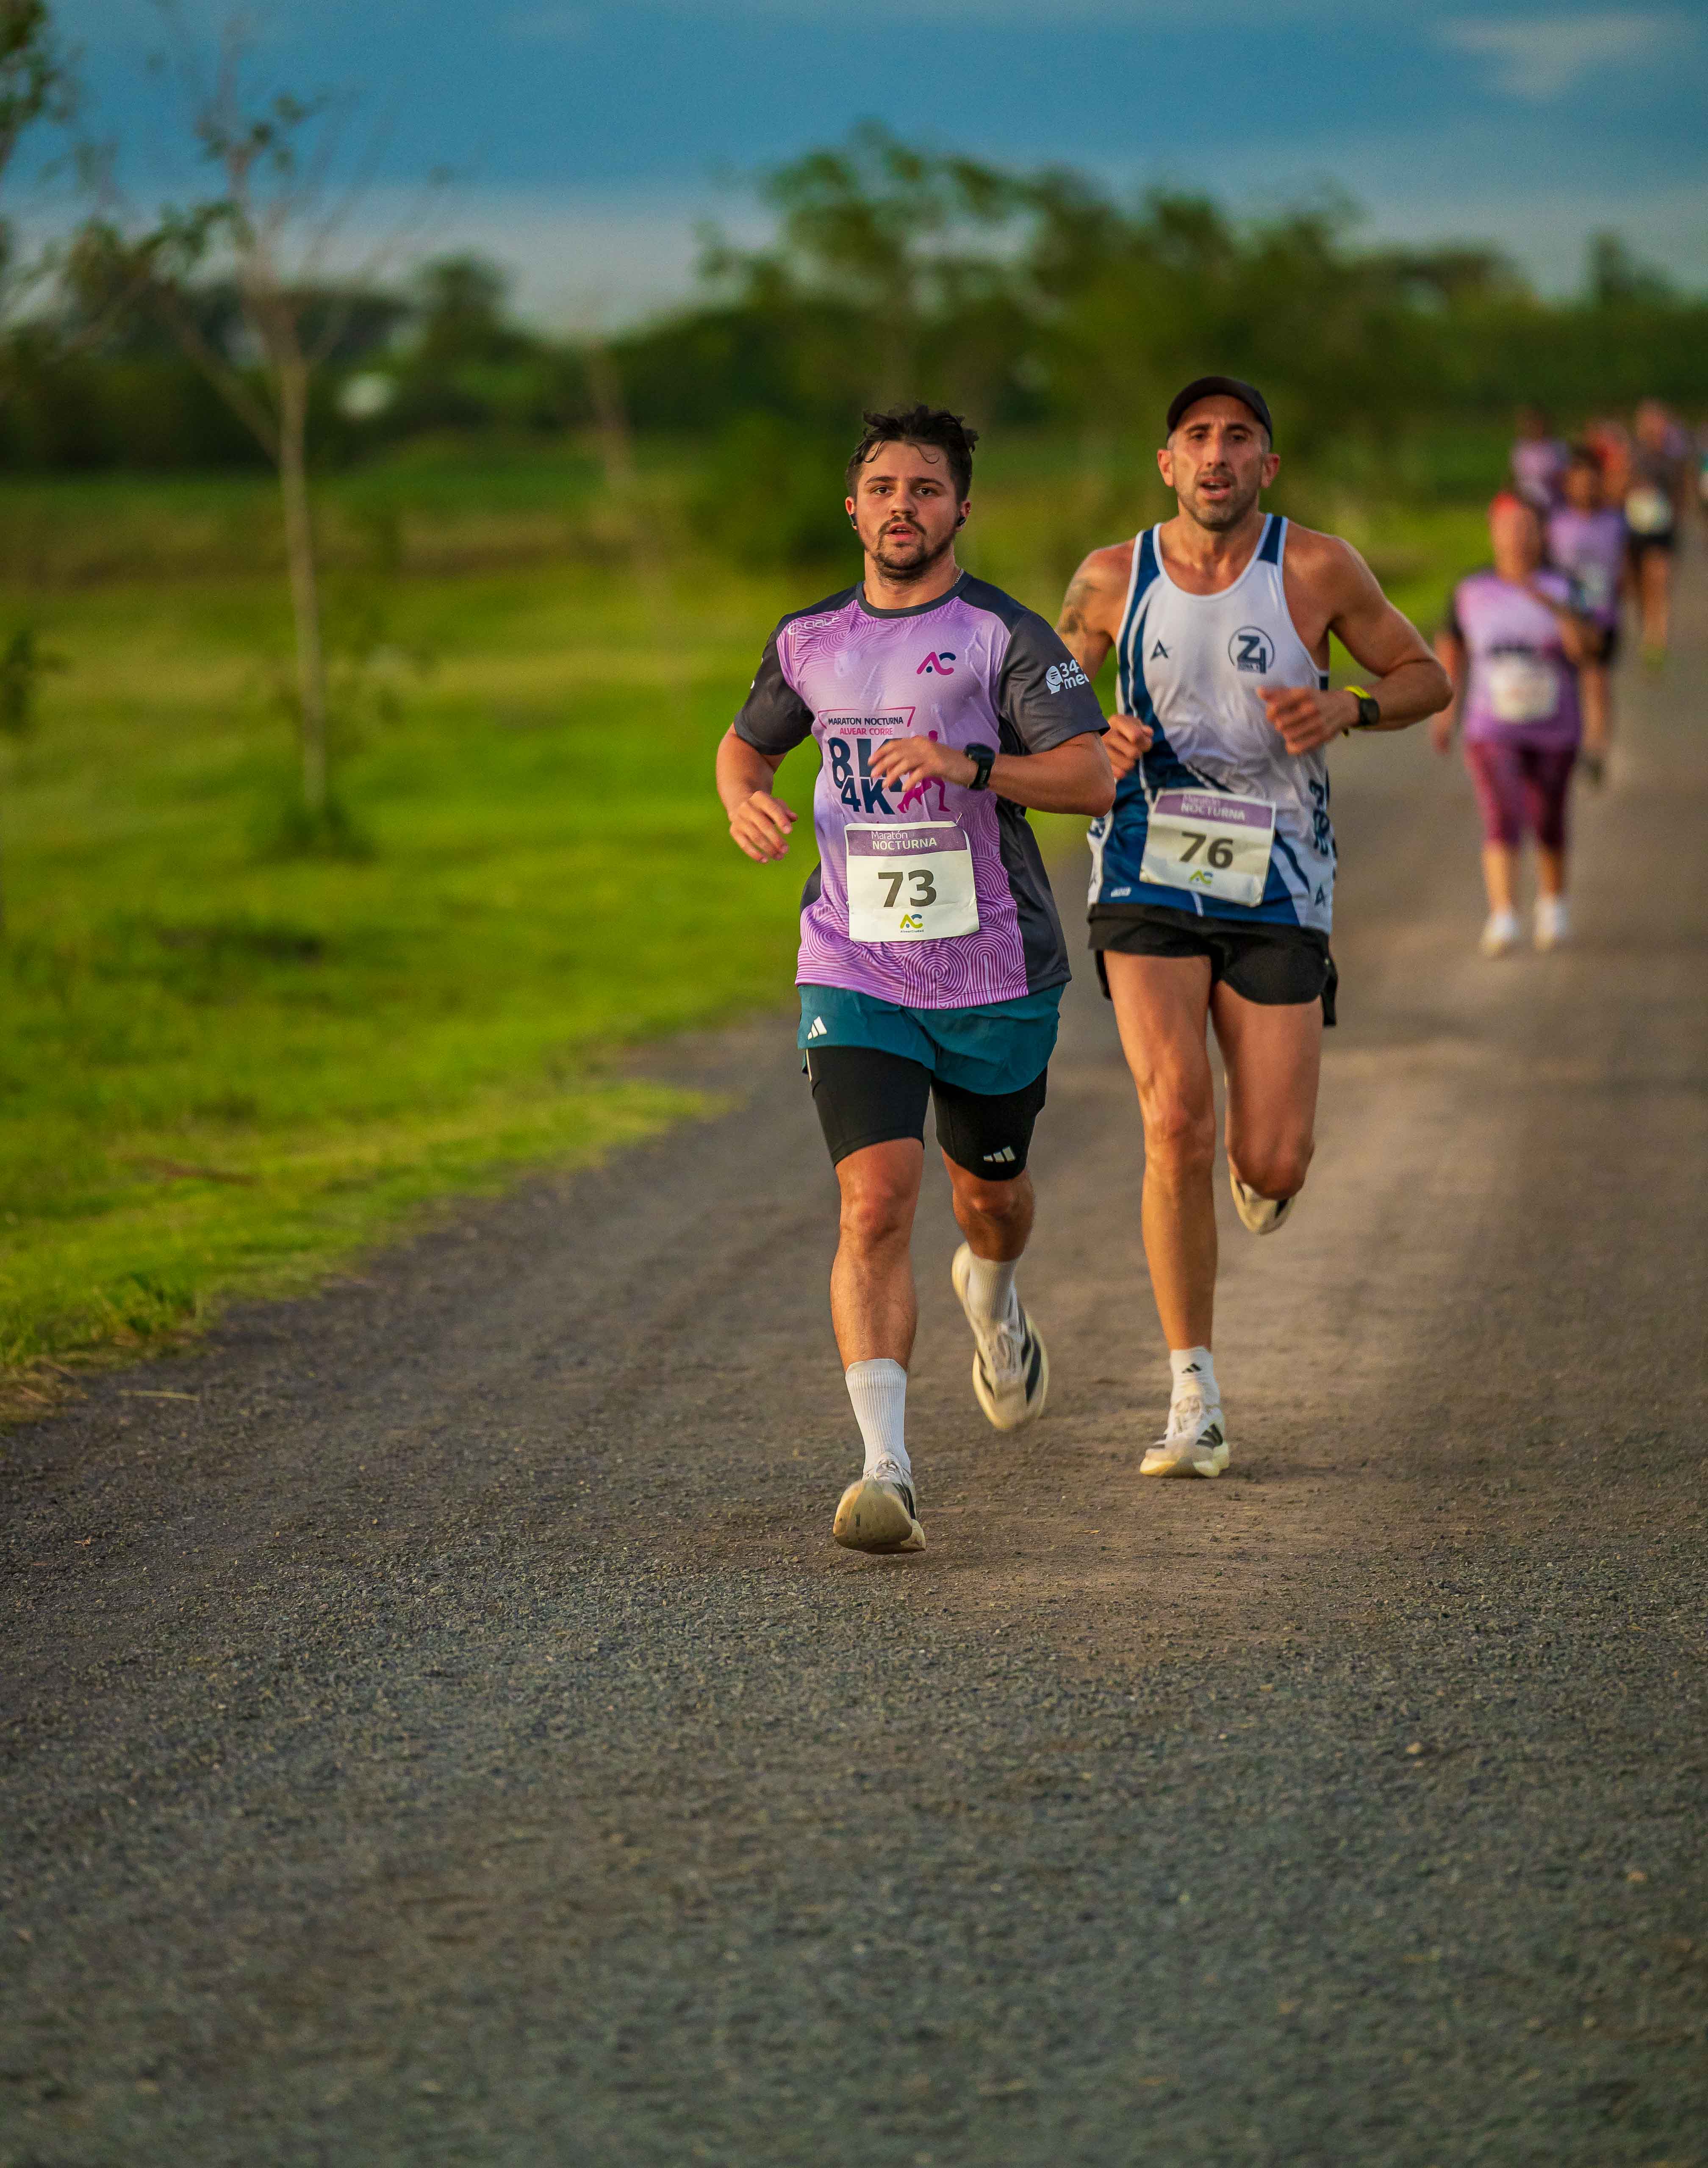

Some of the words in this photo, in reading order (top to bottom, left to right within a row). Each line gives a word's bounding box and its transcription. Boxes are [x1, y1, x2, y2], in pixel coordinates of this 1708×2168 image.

[1059, 659, 1083, 678] 34
[828, 717, 862, 725] MARATON
[865, 716, 904, 725] NOCTURNA
[840, 777, 896, 815] 4K
[871, 830, 908, 840] Maratón
[872, 837, 937, 850] NOCTURNA
[1179, 831, 1233, 869] 76
[878, 869, 937, 907] 73
